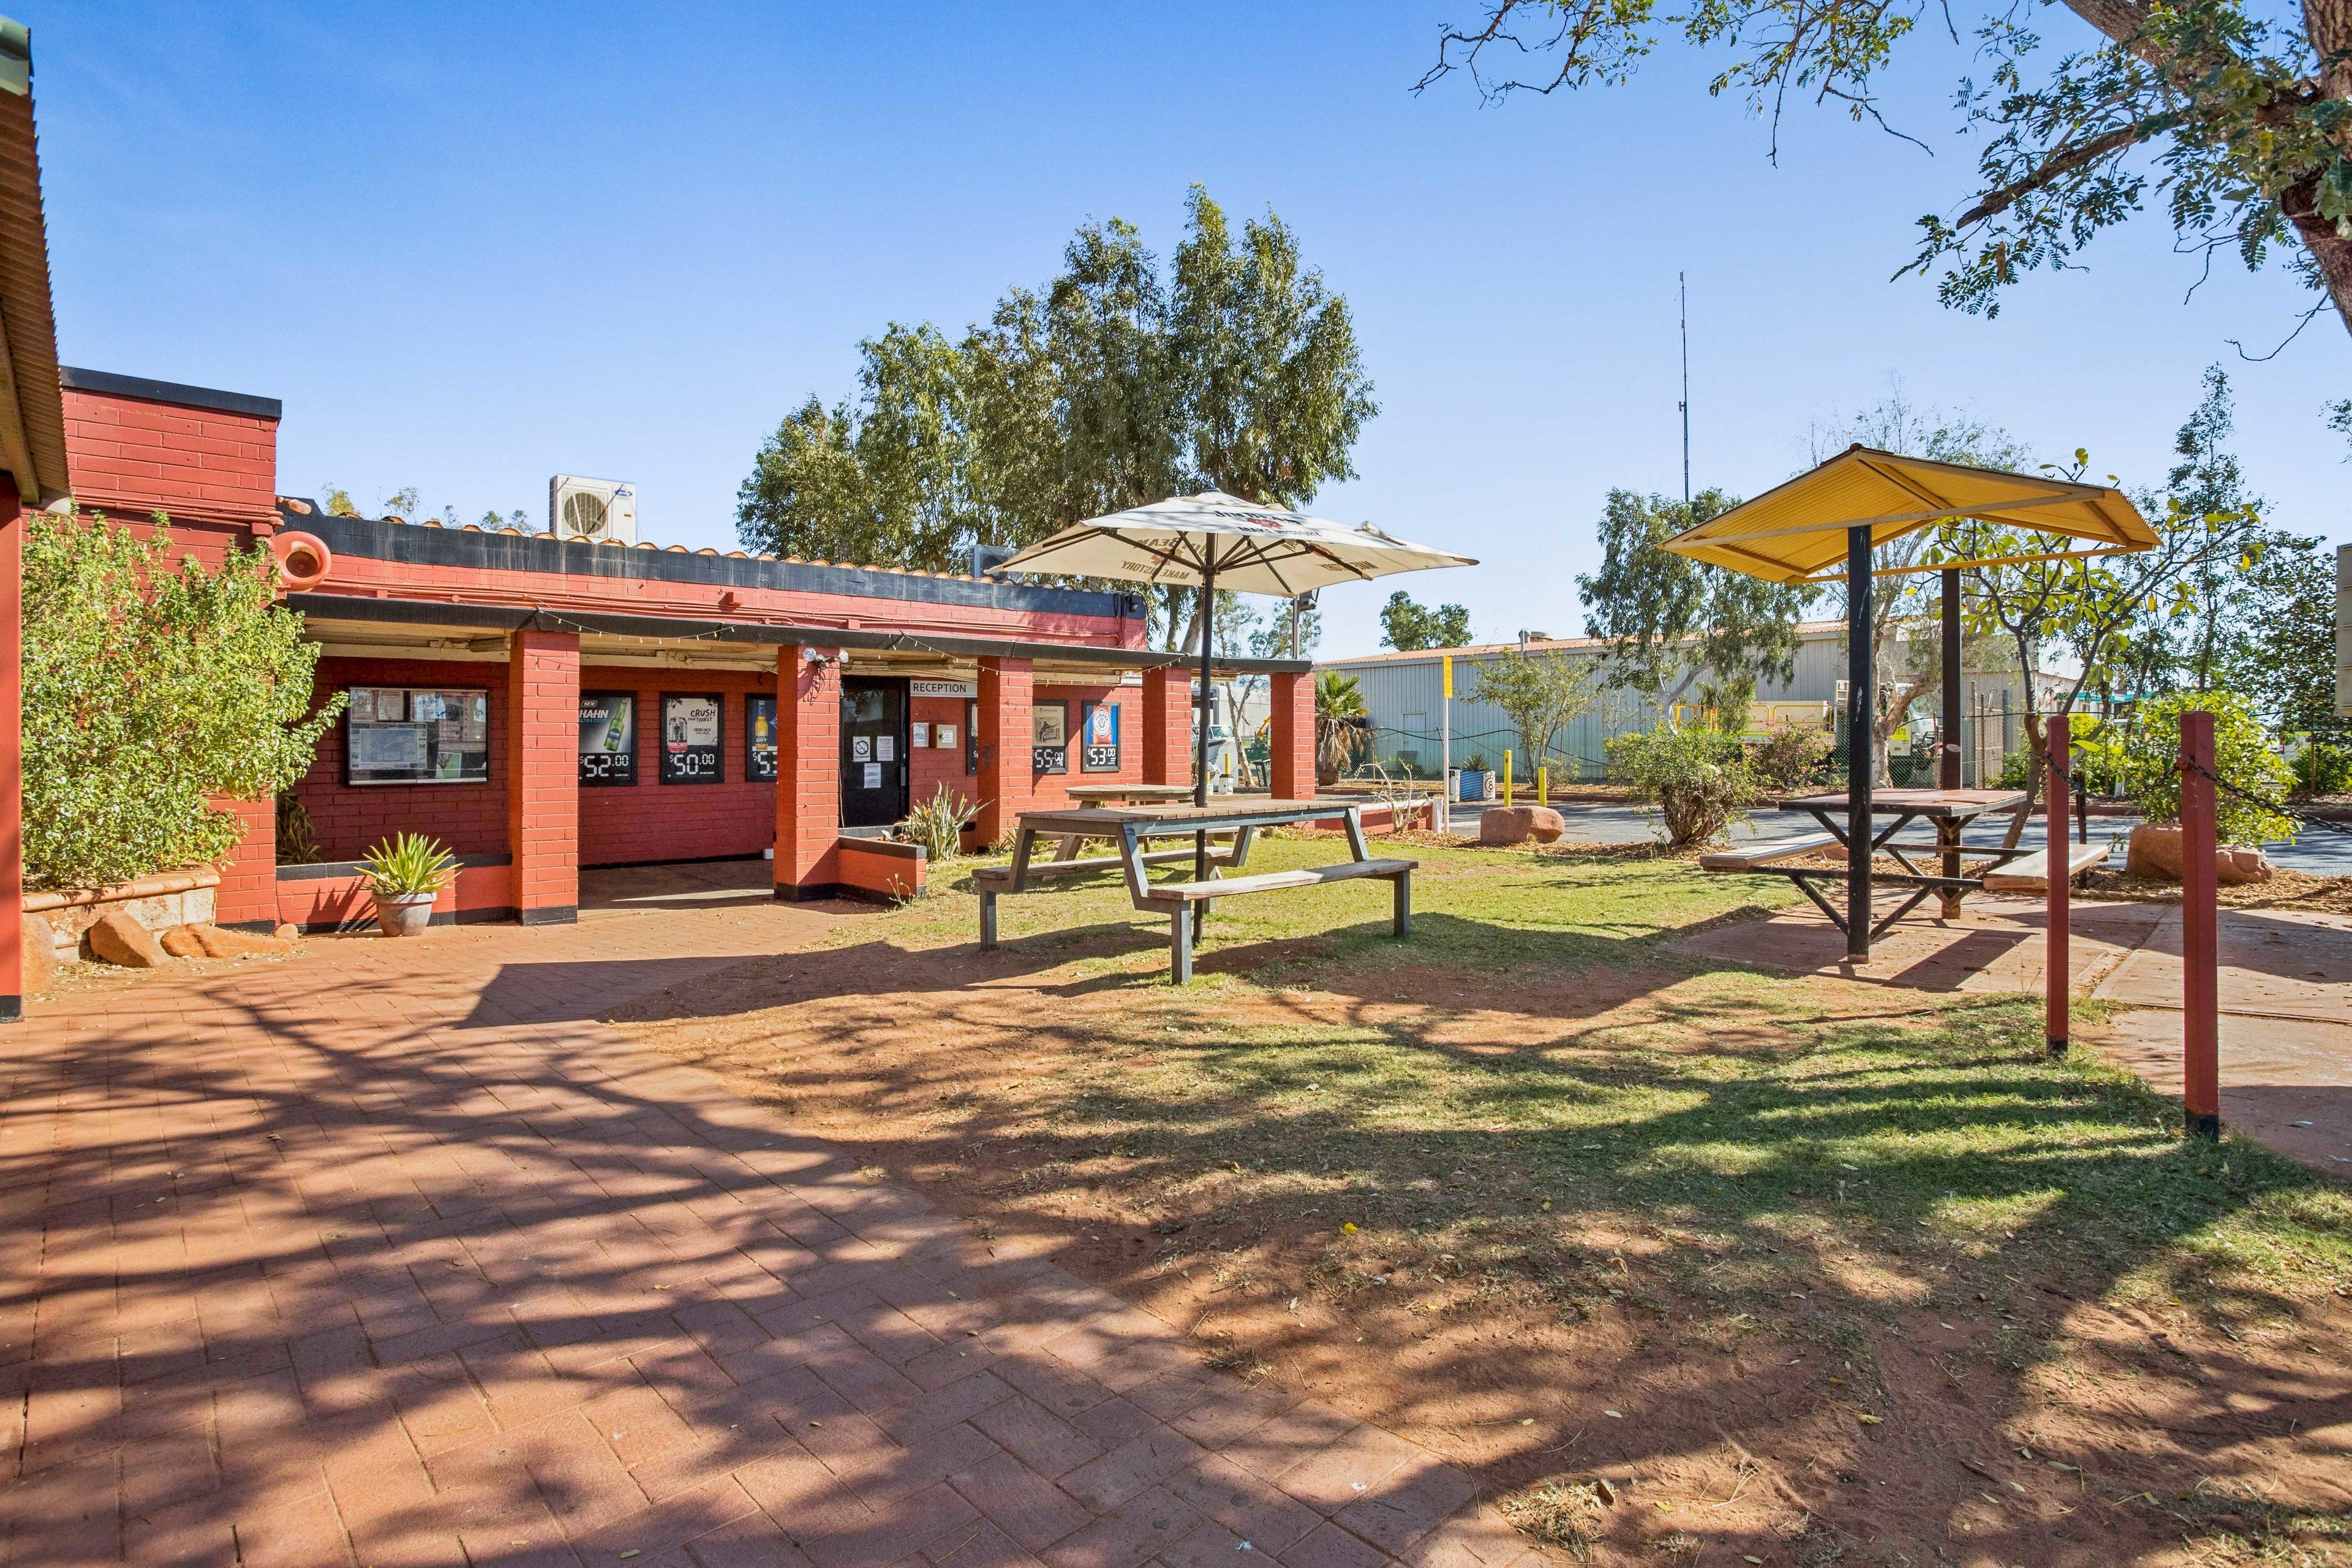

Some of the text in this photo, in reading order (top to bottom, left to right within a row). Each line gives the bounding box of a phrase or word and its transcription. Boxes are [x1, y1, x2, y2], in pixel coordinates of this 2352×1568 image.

[913, 683, 967, 693] RECEPTION
[579, 709, 609, 718] HAHN
[690, 709, 716, 717] CRUSH
[1087, 748, 1116, 765] $53.00
[579, 755, 628, 777] $52.00
[669, 754, 715, 775] $50.00
[1488, 780, 1493, 790] 8
